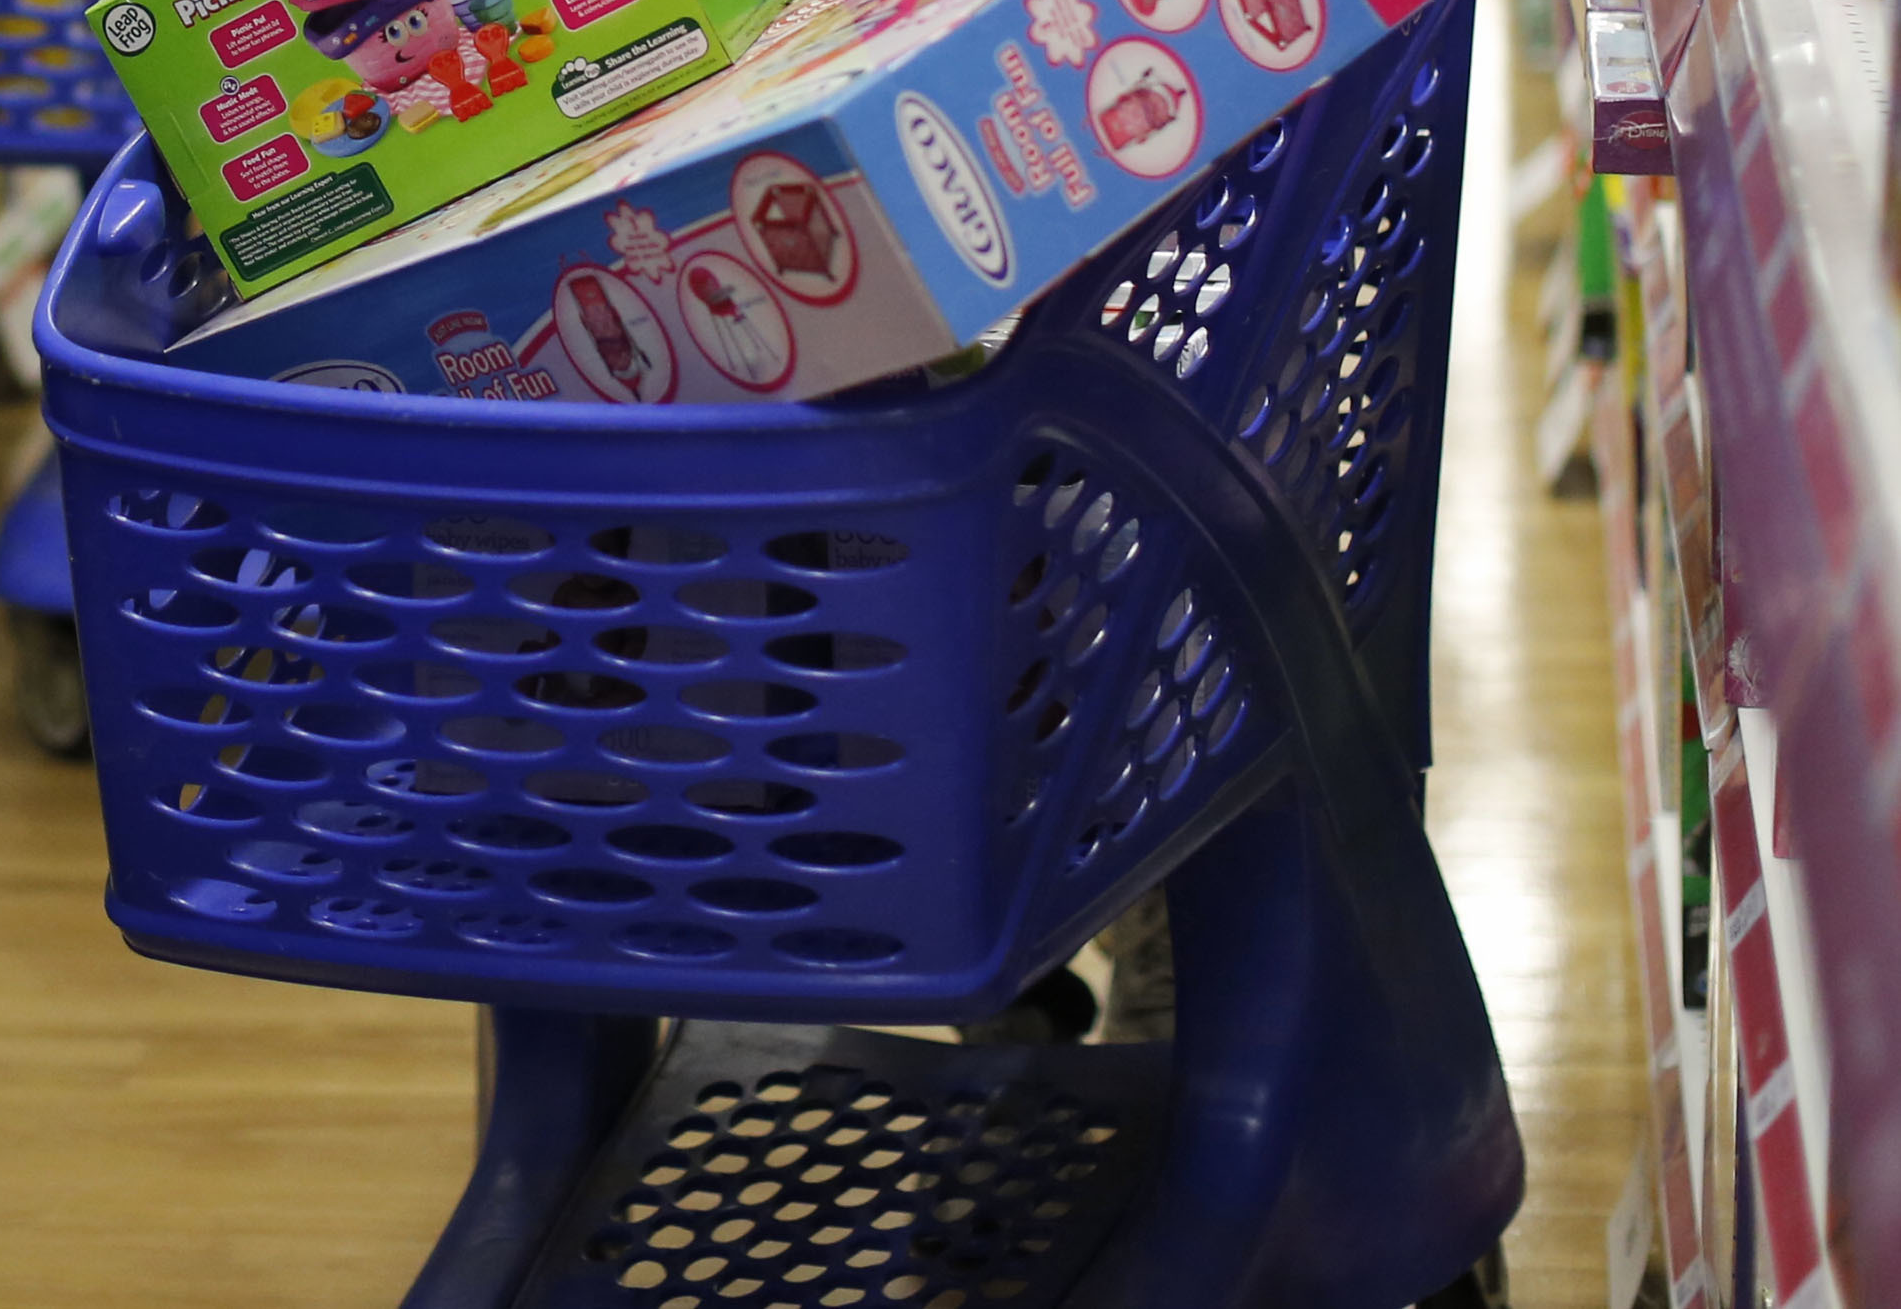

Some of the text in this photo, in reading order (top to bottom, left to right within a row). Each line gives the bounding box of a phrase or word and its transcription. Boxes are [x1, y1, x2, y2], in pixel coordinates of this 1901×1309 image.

[107, 6, 139, 38] Leap
[118, 17, 151, 49] Frog
[230, 21, 253, 37] Picnic
[604, 22, 687, 69] Share the Learning
[561, 73, 587, 90] Learning
[994, 44, 1041, 107] Fun
[215, 85, 258, 111] Music Mode
[987, 90, 1054, 189] Room
[1027, 107, 1060, 145] of
[260, 146, 276, 158] Fun
[289, 184, 315, 202] Learning
[313, 174, 333, 190] Expert
[906, 113, 996, 257] GRACO
[1044, 143, 1093, 206] Full
[438, 342, 514, 385] Room
[508, 369, 558, 402] Fun
